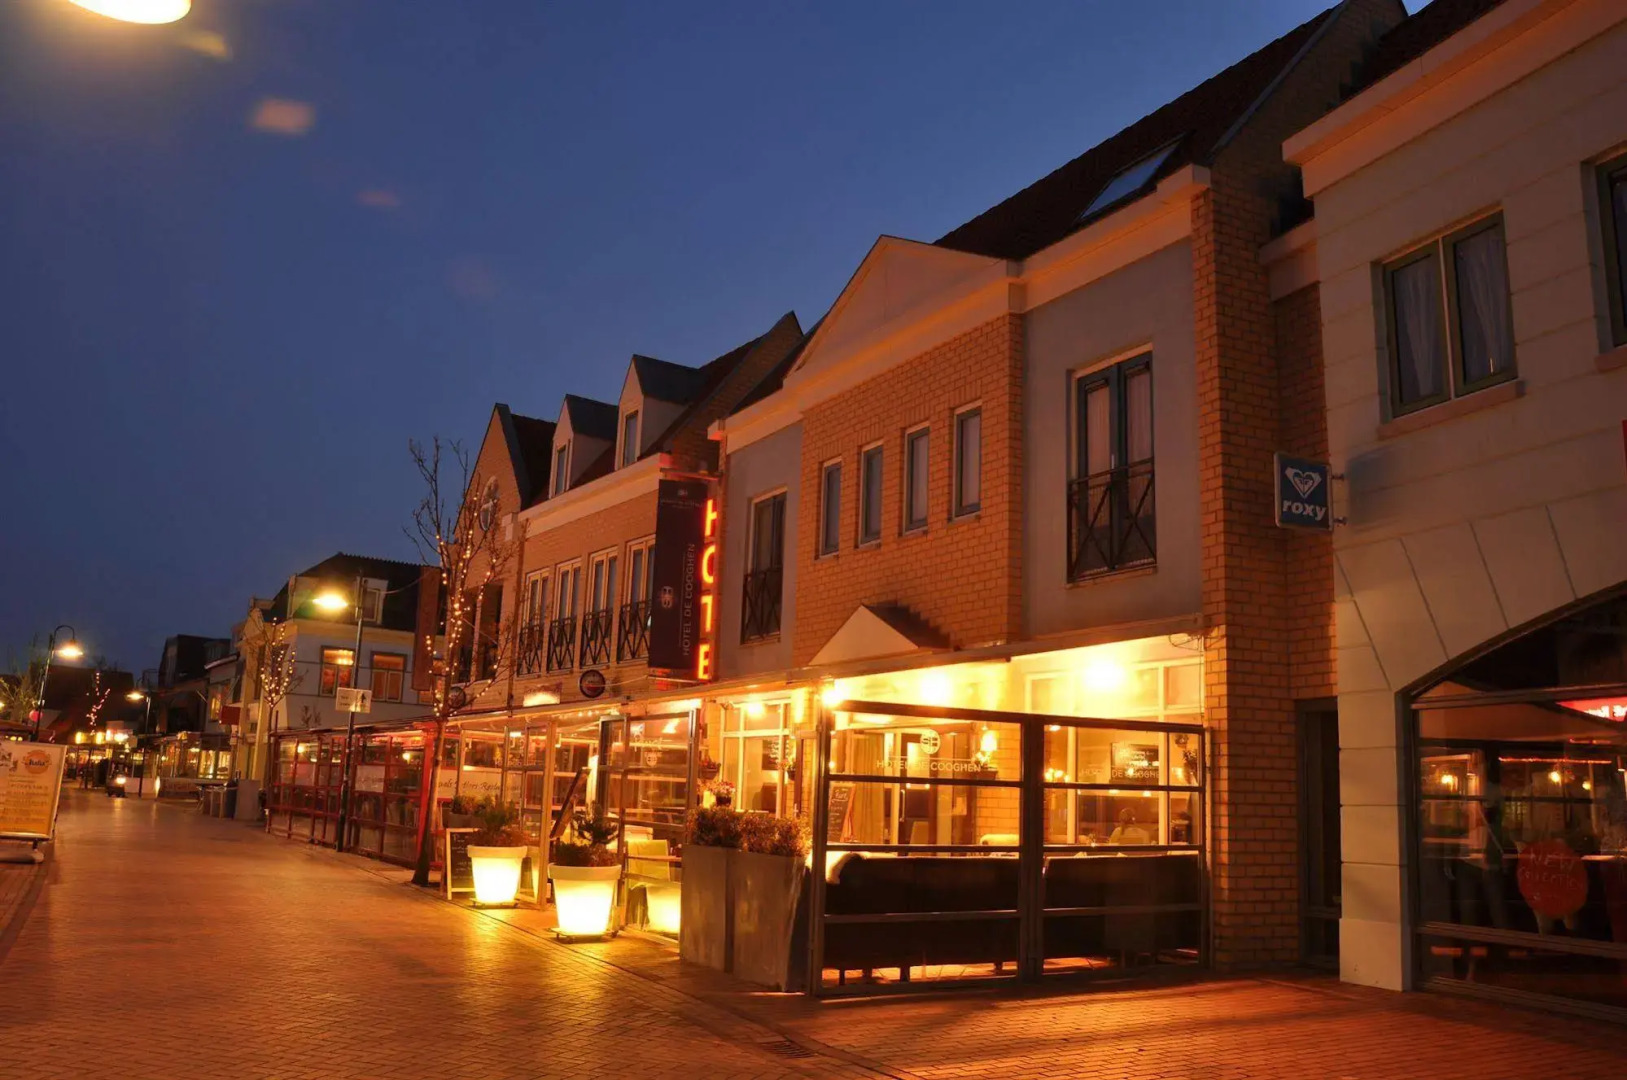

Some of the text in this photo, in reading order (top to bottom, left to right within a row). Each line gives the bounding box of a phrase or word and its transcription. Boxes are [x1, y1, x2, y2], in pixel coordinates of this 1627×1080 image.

[1282, 500, 1327, 521] roxy
[683, 601, 693, 617] DE
[682, 620, 692, 656] HOTEL
[930, 761, 981, 772] COOGHEN
